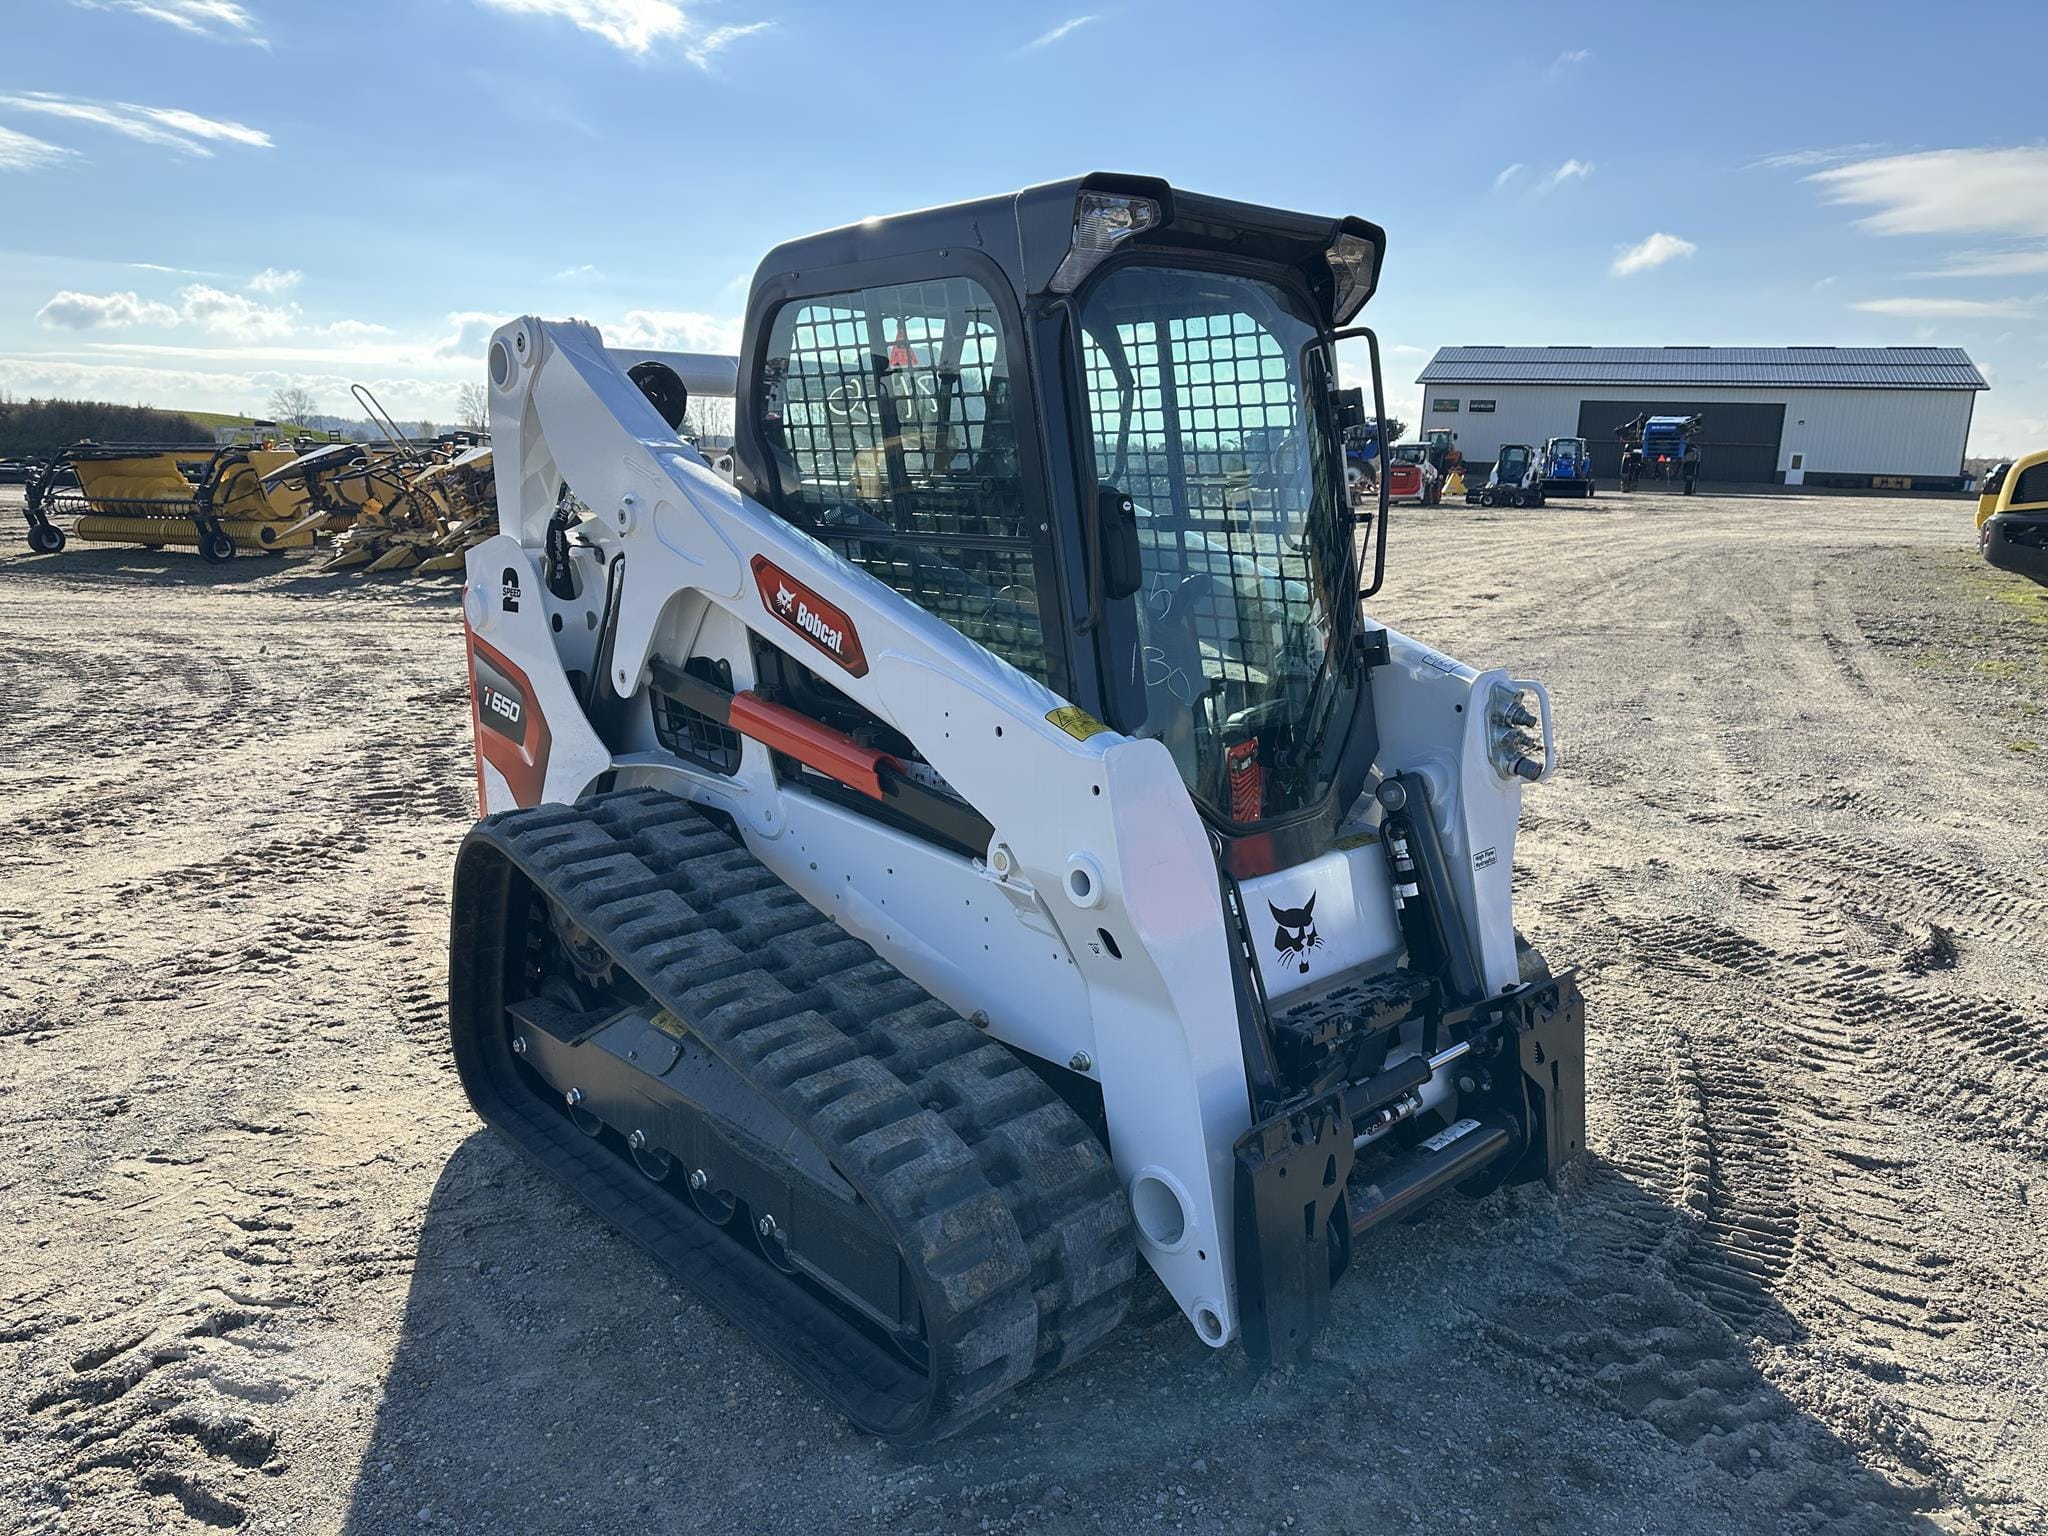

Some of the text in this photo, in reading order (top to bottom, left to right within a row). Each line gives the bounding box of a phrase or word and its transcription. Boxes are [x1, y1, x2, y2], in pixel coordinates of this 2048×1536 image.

[502, 567, 521, 613] 2 SPEED
[1150, 571, 1172, 621] 5
[796, 602, 843, 653] Bobcat
